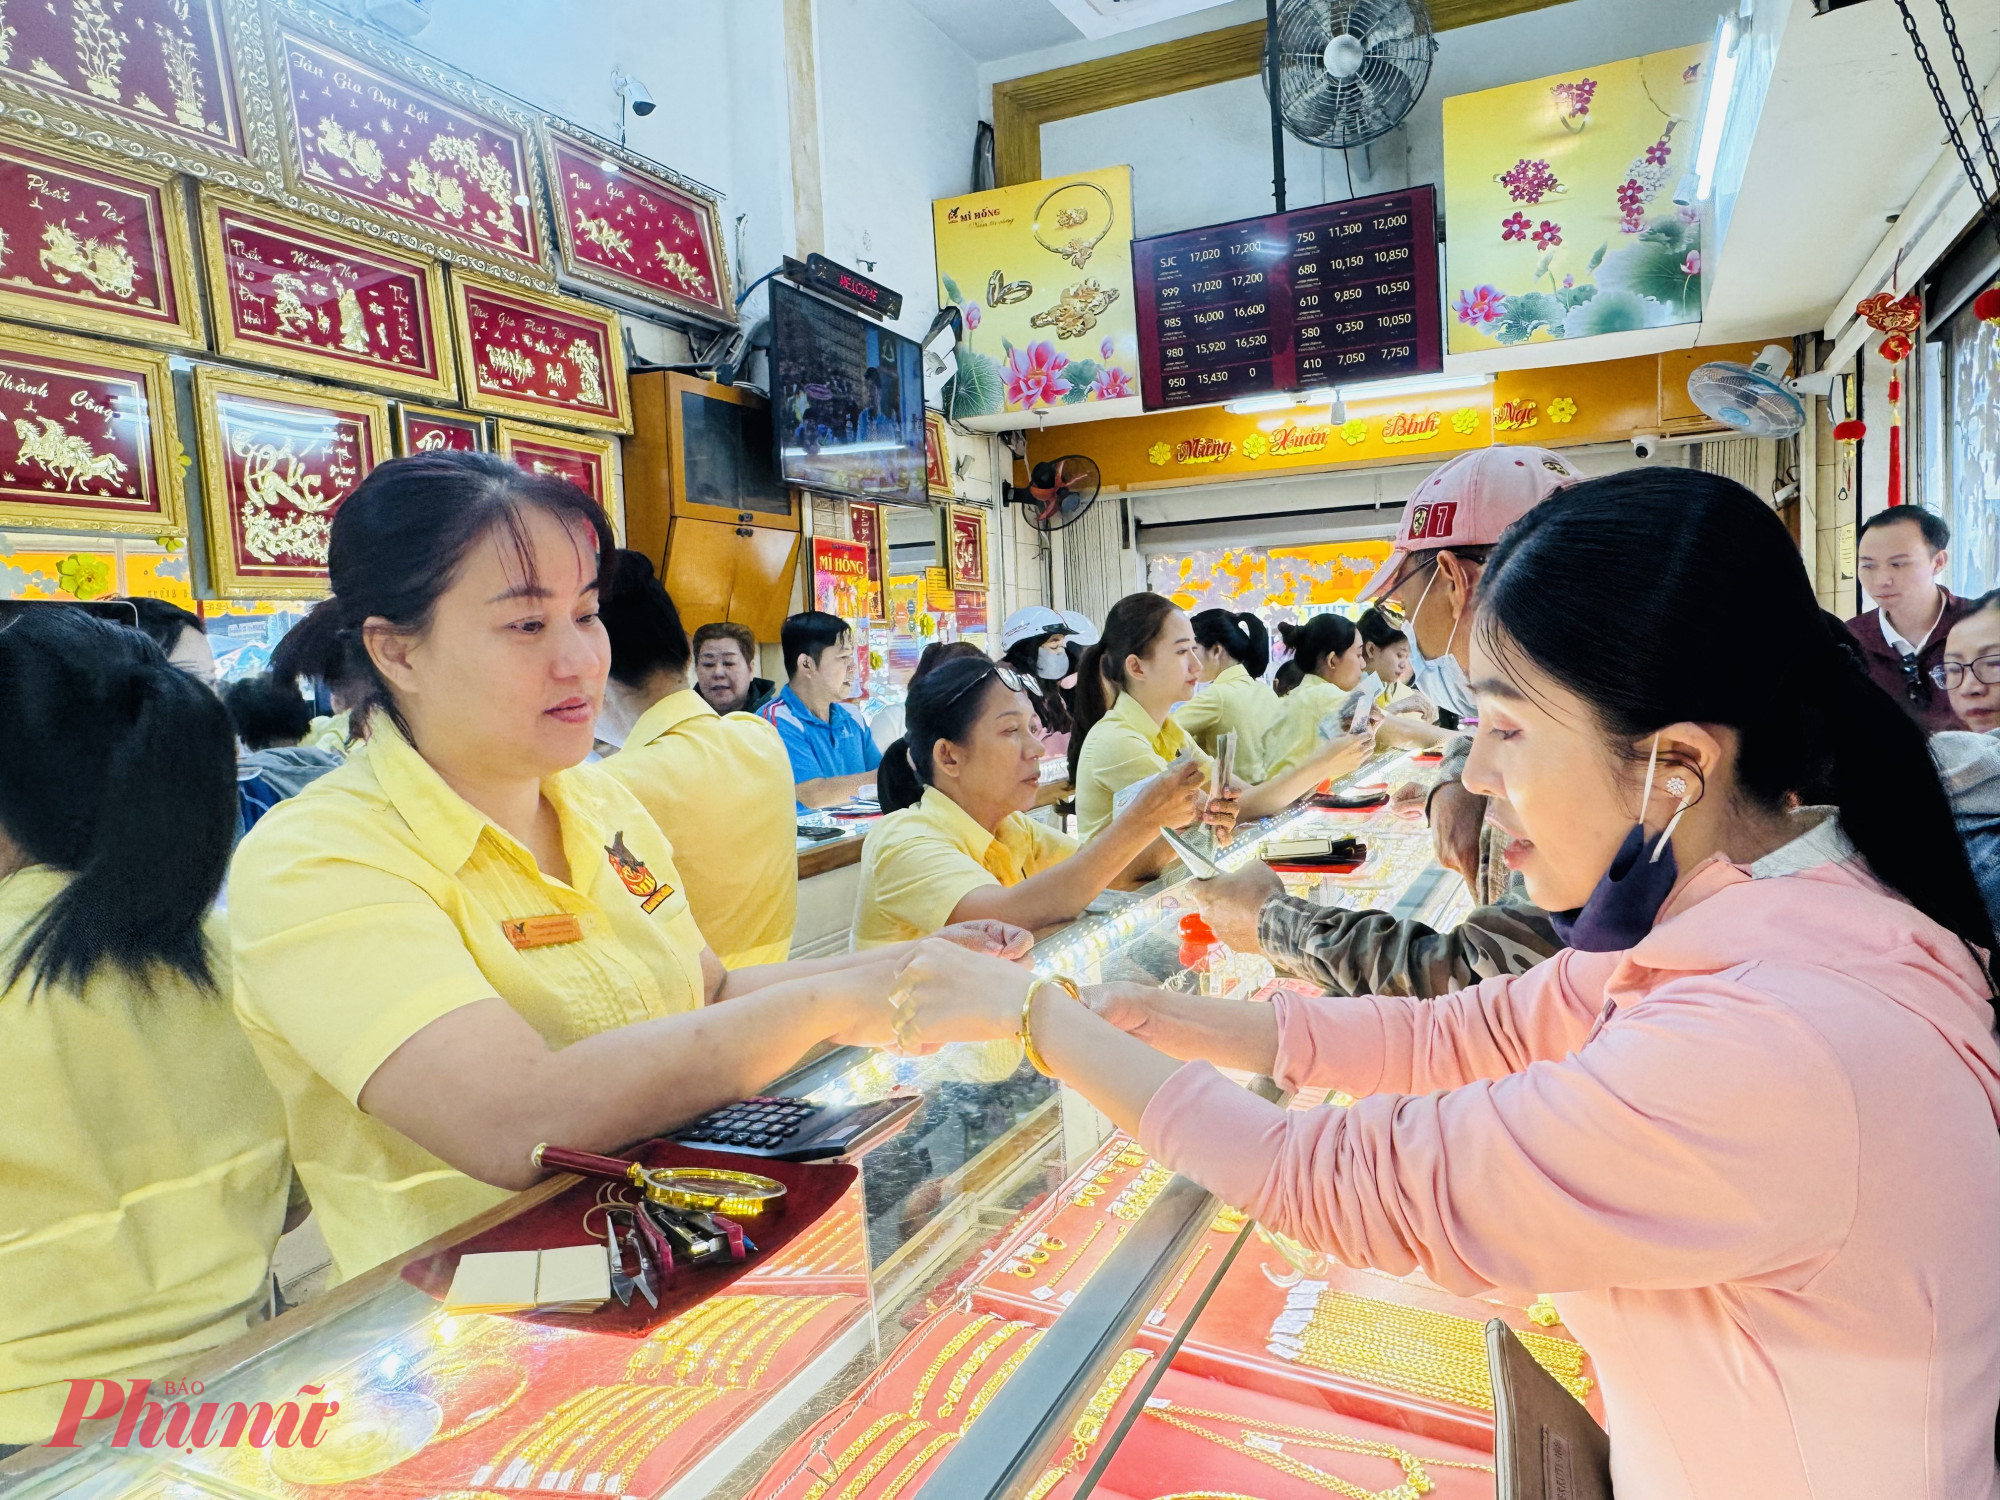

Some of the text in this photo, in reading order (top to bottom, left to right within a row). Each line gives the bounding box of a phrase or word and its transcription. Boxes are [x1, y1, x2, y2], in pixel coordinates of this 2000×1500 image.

[333, 72, 363, 95] Gia
[1296, 214, 1407, 244] 750 11,300 12,000
[1160, 241, 1261, 268] SJC 17,020 17,200
[1297, 247, 1409, 275] 680 10,150 10,850
[840, 274, 879, 302] WELCOME
[1162, 272, 1263, 299] 999 17,020 17,200
[1299, 281, 1410, 307] 610 9,850 10,550
[1164, 304, 1265, 329] 985 16,000 16,600
[1301, 313, 1411, 338] 580 9,350 10,050
[1166, 334, 1267, 359] 980 15,920 16,520
[1303, 346, 1410, 369] 410 7,050 7,750
[1168, 367, 1256, 388] 950 15,430 0
[71, 390, 113, 422] Công
[835, 551, 864, 575] HỒNG
